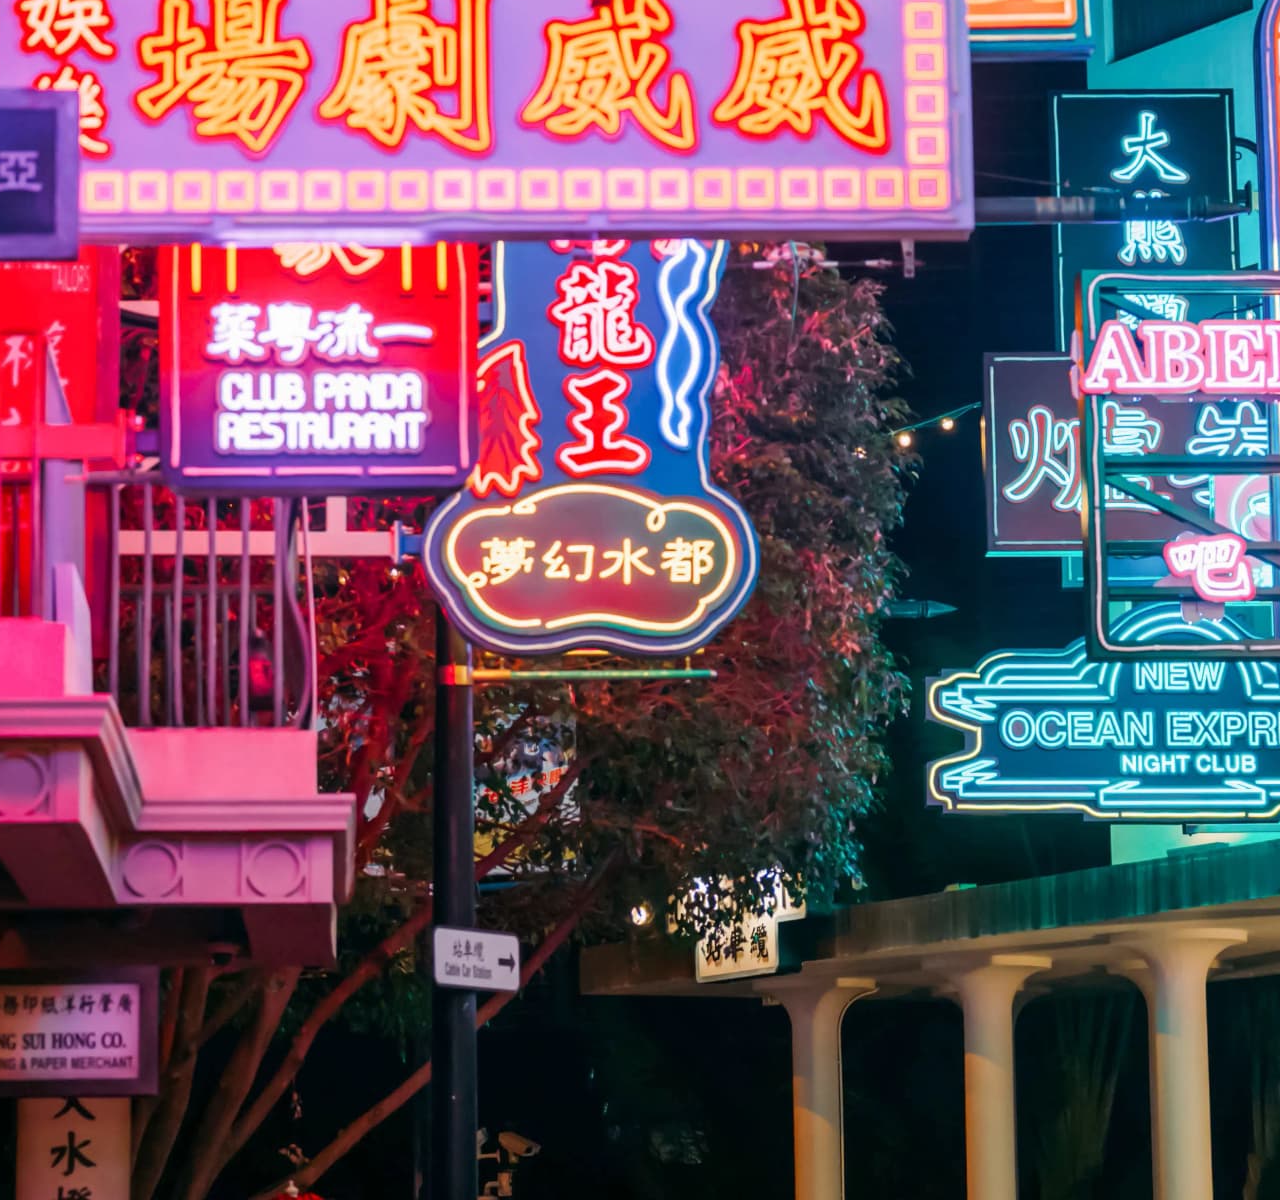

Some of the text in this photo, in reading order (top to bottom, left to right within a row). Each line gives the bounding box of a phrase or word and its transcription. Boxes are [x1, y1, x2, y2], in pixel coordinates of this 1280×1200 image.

[547, 240, 656, 476] 龍王
[219, 371, 423, 412] CLUB PANDA
[216, 411, 429, 452] RESTAURANT
[479, 536, 716, 586] 夢幻水都
[1134, 661, 1223, 691] NEW
[1000, 709, 1154, 749] OCEAN
[1121, 753, 1258, 775] NIGHT CLUB
[22, 1033, 46, 1050] SUI
[51, 1032, 96, 1050] HONG
[101, 1032, 126, 1049] CO.
[30, 1058, 67, 1071] PAPER
[71, 1056, 133, 1070] MERCHANT
